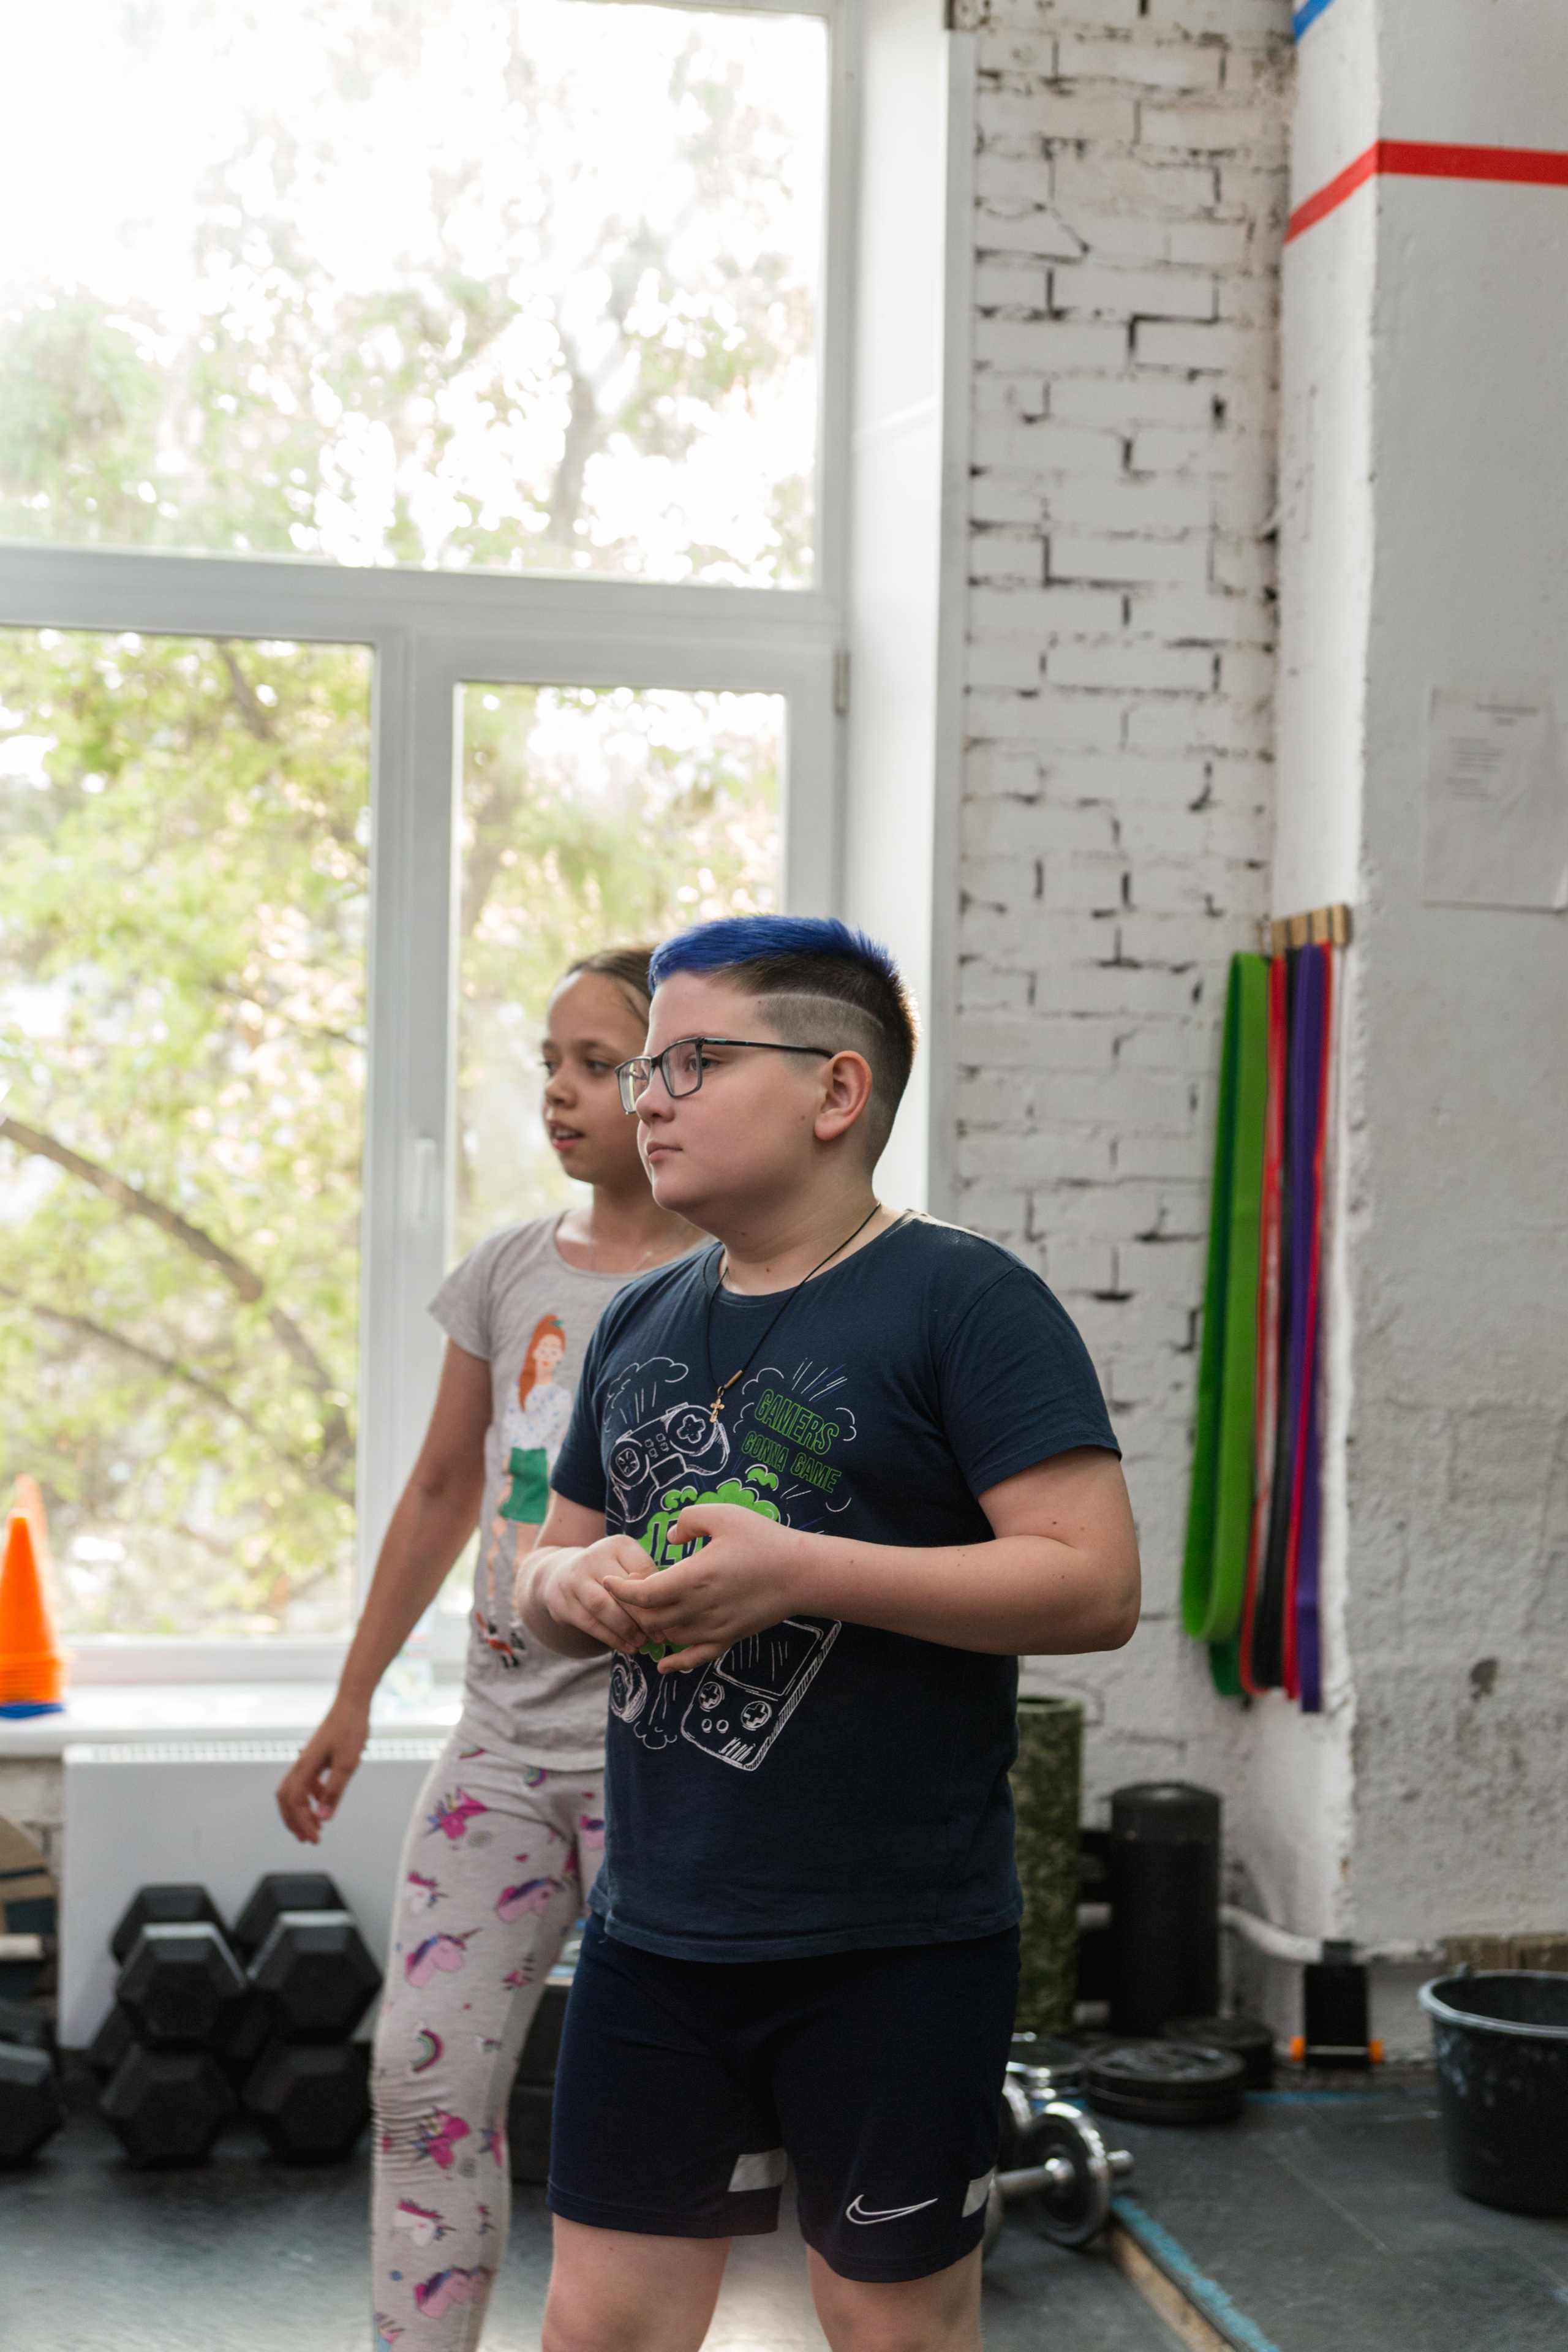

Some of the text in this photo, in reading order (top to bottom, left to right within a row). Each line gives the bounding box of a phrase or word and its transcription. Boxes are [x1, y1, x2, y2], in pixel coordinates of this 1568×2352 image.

[754, 1389, 840, 1455] GAMERS
[741, 1431, 842, 1493] GONNA GAME
